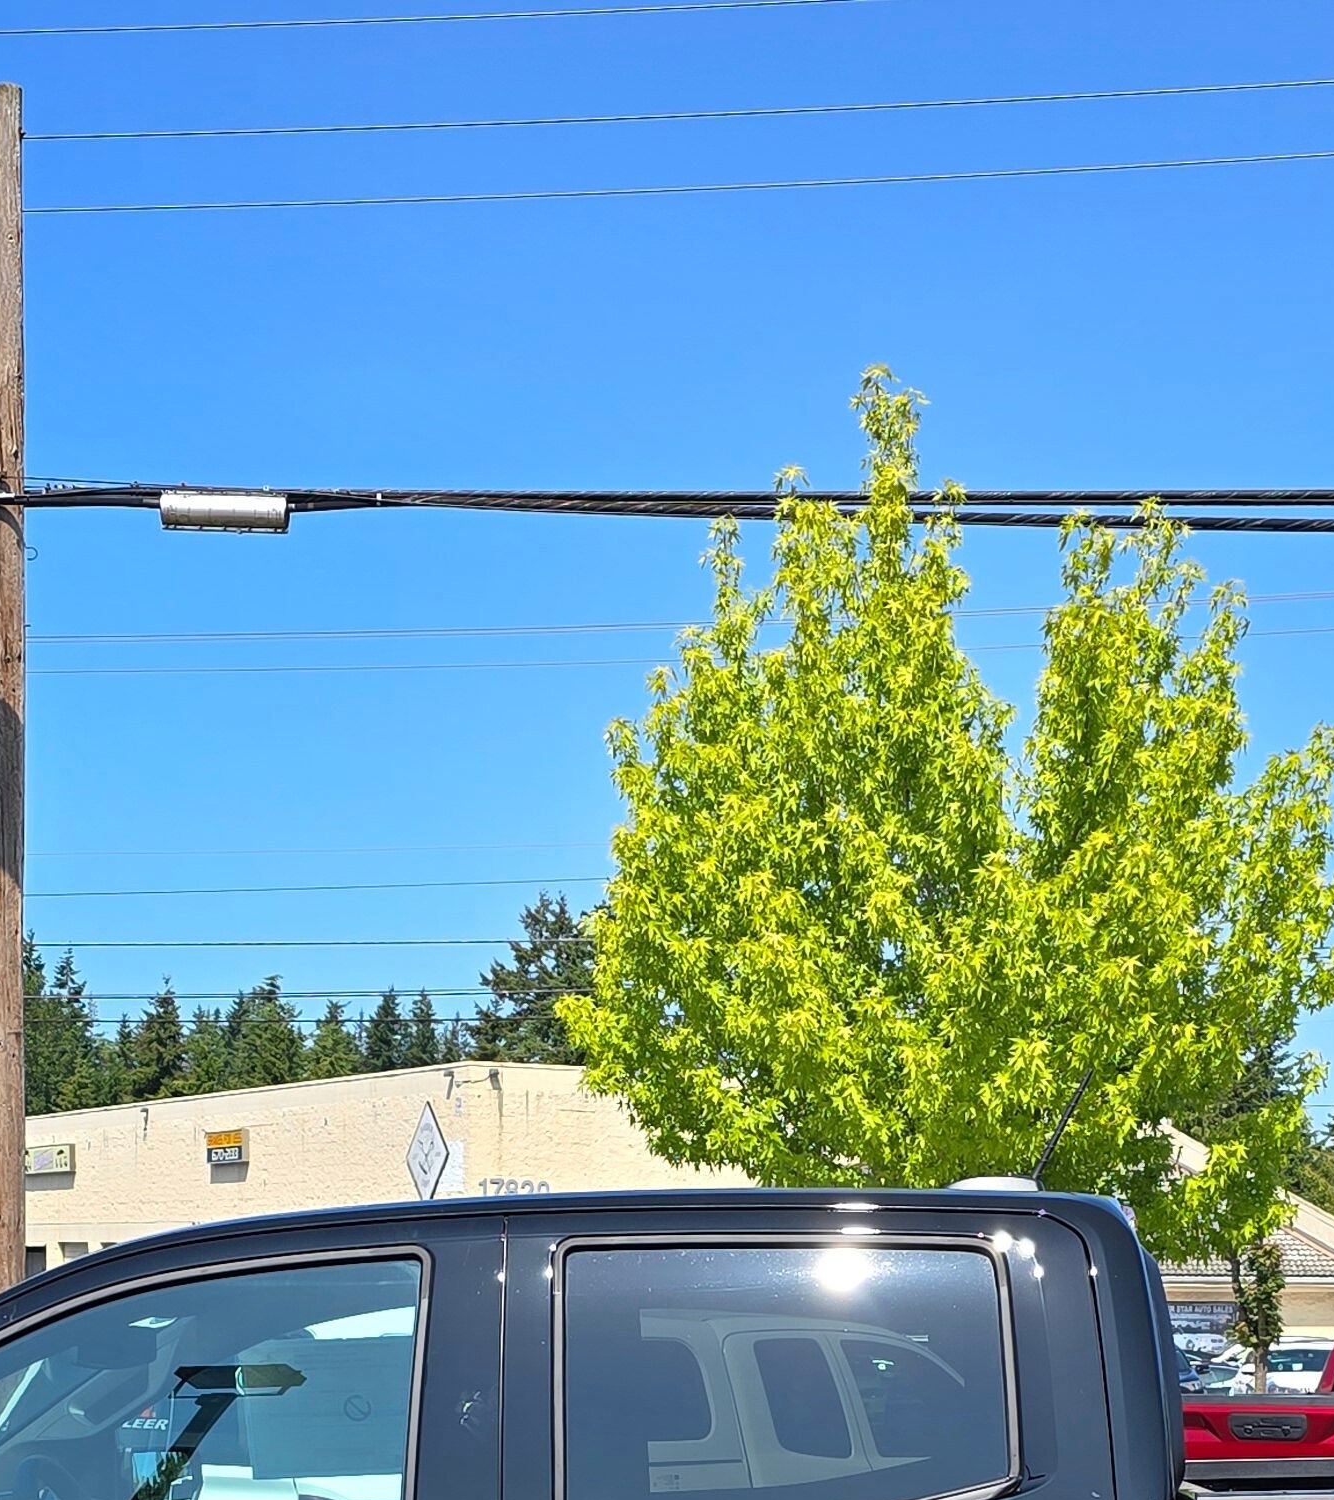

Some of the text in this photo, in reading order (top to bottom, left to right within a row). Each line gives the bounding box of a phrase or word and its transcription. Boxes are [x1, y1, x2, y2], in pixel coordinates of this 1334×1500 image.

[1176, 1305, 1193, 1313] STAR
[1194, 1305, 1212, 1313] AUTO
[1212, 1305, 1234, 1314] SALES
[121, 1418, 169, 1430] LEER
